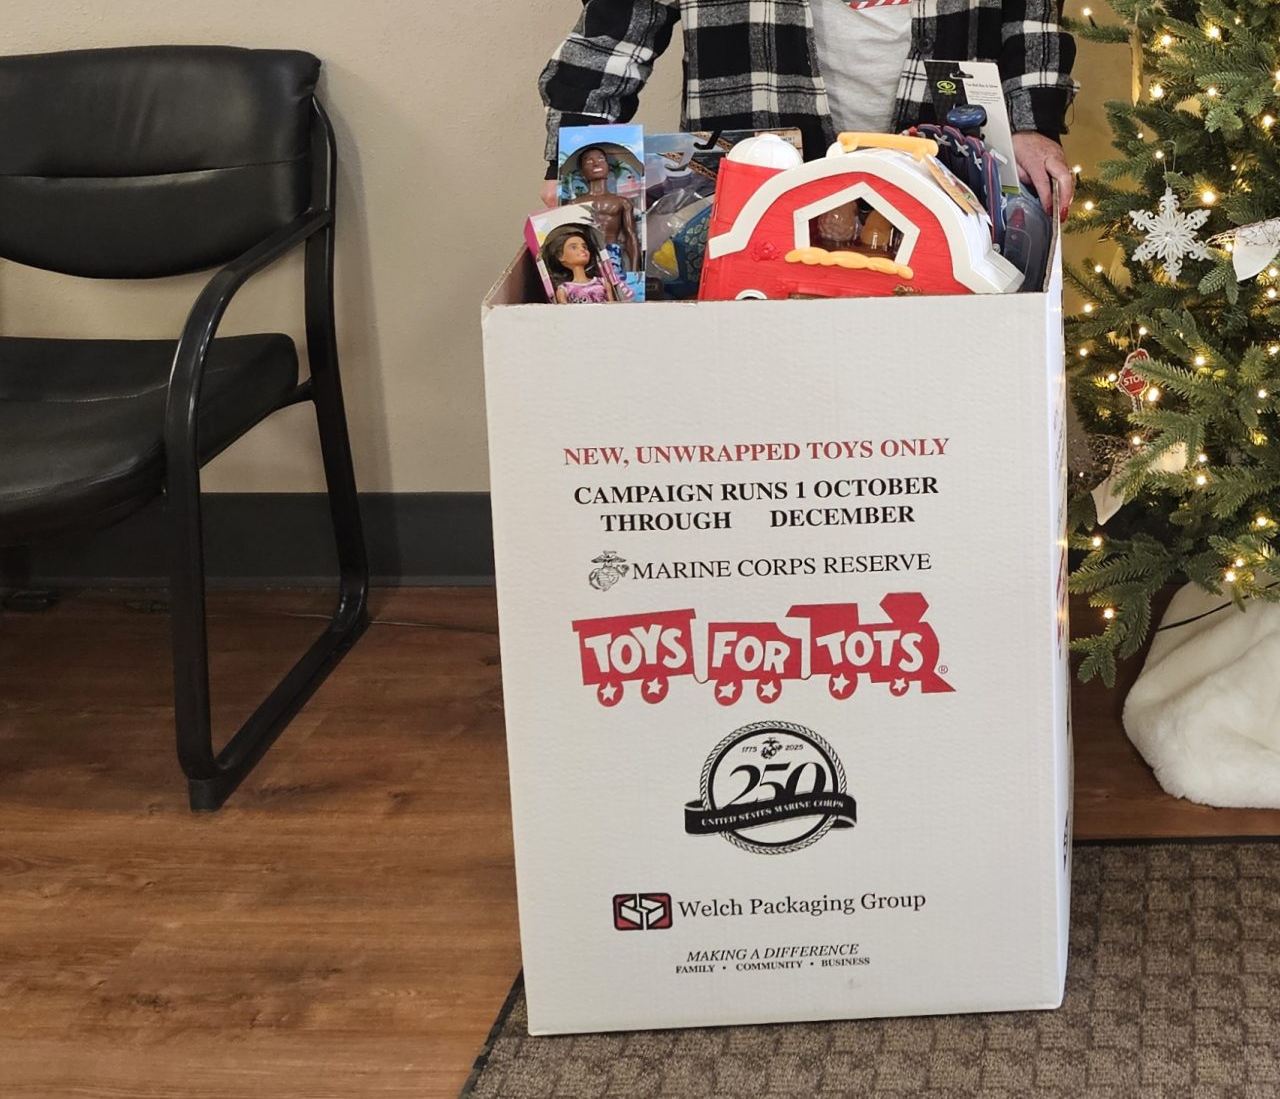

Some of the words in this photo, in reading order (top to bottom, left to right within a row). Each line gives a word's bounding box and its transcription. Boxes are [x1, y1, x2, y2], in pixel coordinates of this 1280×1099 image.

[563, 446, 629, 467] NEW,
[636, 443, 801, 465] UNWRAPPED
[807, 439, 873, 460] TOYS
[880, 437, 950, 458] ONLY
[574, 483, 714, 505] CAMPAIGN
[721, 481, 788, 502] RUNS
[796, 481, 806, 499] 1
[814, 476, 939, 499] OCTOBER
[601, 511, 731, 533] THROUGH
[770, 505, 915, 528] DECEMBER
[632, 560, 731, 581] MARINE
[737, 557, 816, 577] CORPS
[823, 553, 932, 575] RESERVE
[585, 624, 687, 673] TOYS
[712, 631, 790, 674] FOR
[815, 630, 924, 673] TOTS
[725, 762, 827, 806] 250
[701, 815, 737, 826] UNITED
[739, 808, 772, 822] STATES
[774, 800, 812, 814] MARINE
[813, 799, 844, 808] CORPS
[676, 899, 743, 917] Welch
[749, 894, 856, 916] Packaging
[860, 892, 926, 912] Group
[675, 963, 715, 974] FAMILY
[736, 960, 803, 972] COMMUNITY
[821, 956, 870, 968] BUSINESS
[687, 949, 747, 963] MAKING
[749, 948, 760, 960] A
[763, 943, 859, 959] DIFFERENCE
